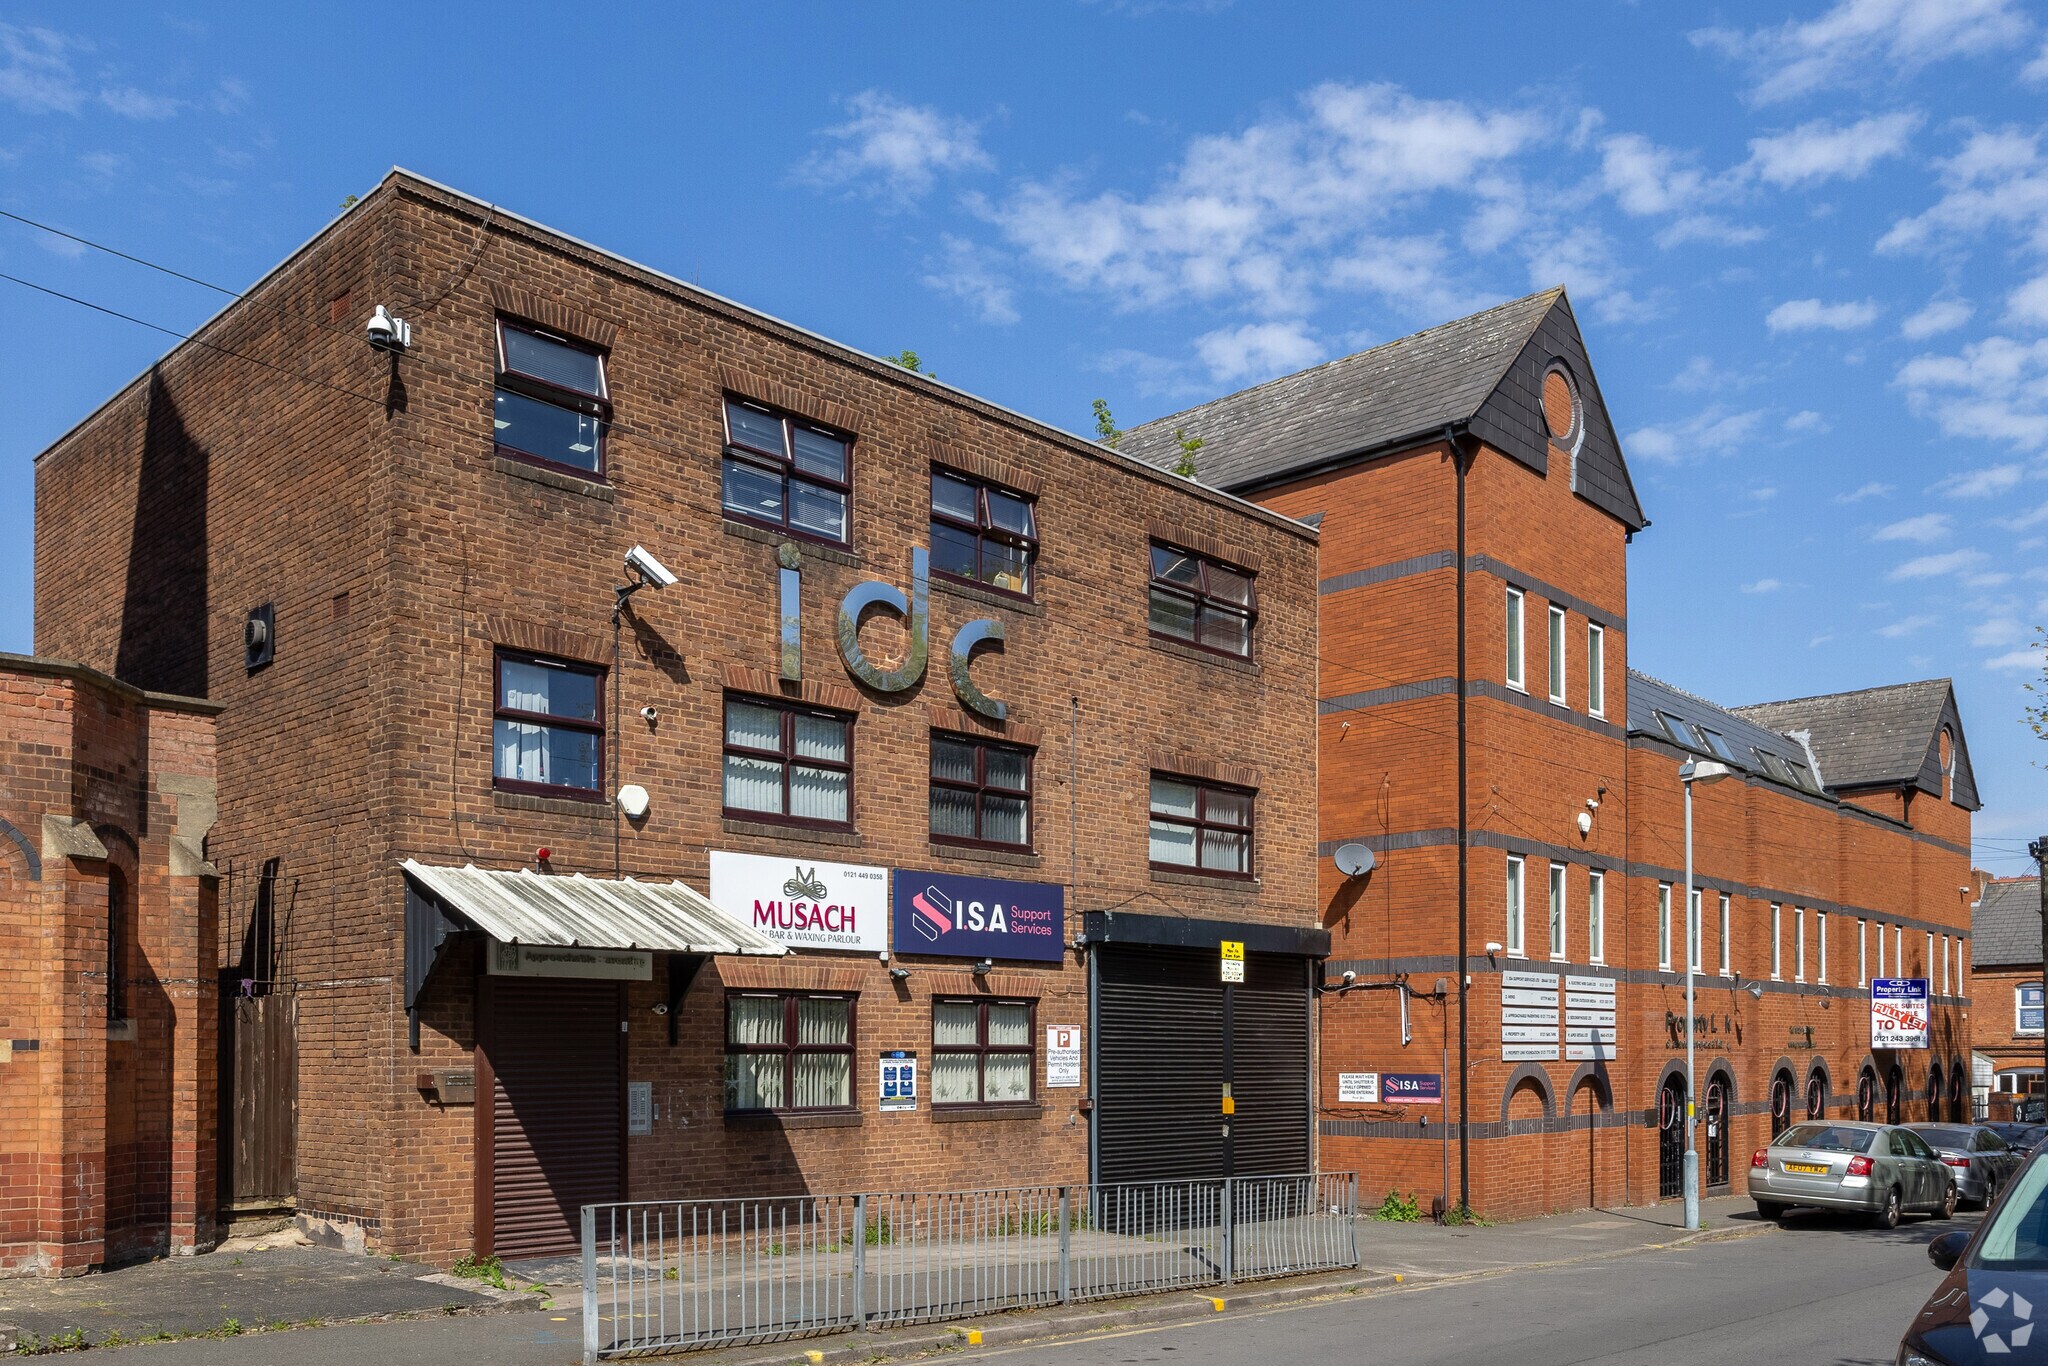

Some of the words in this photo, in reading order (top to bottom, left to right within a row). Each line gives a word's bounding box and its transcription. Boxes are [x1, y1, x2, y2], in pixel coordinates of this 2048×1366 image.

[843, 871, 857, 879] 0121
[753, 899, 856, 933] MUSACH
[1011, 905, 1051, 922] Support
[1011, 921, 1052, 936] Services
[769, 931, 785, 940] BAR
[787, 932, 794, 940] &
[794, 933, 826, 943] WAXING
[827, 934, 861, 945] PARLOUR
[1876, 986, 1905, 994] Property
[1874, 1004, 1906, 1020] FULLY
[1907, 1015, 1925, 1030] LET
[1876, 1020, 1895, 1030] TO
[1060, 1033, 1068, 1045] P
